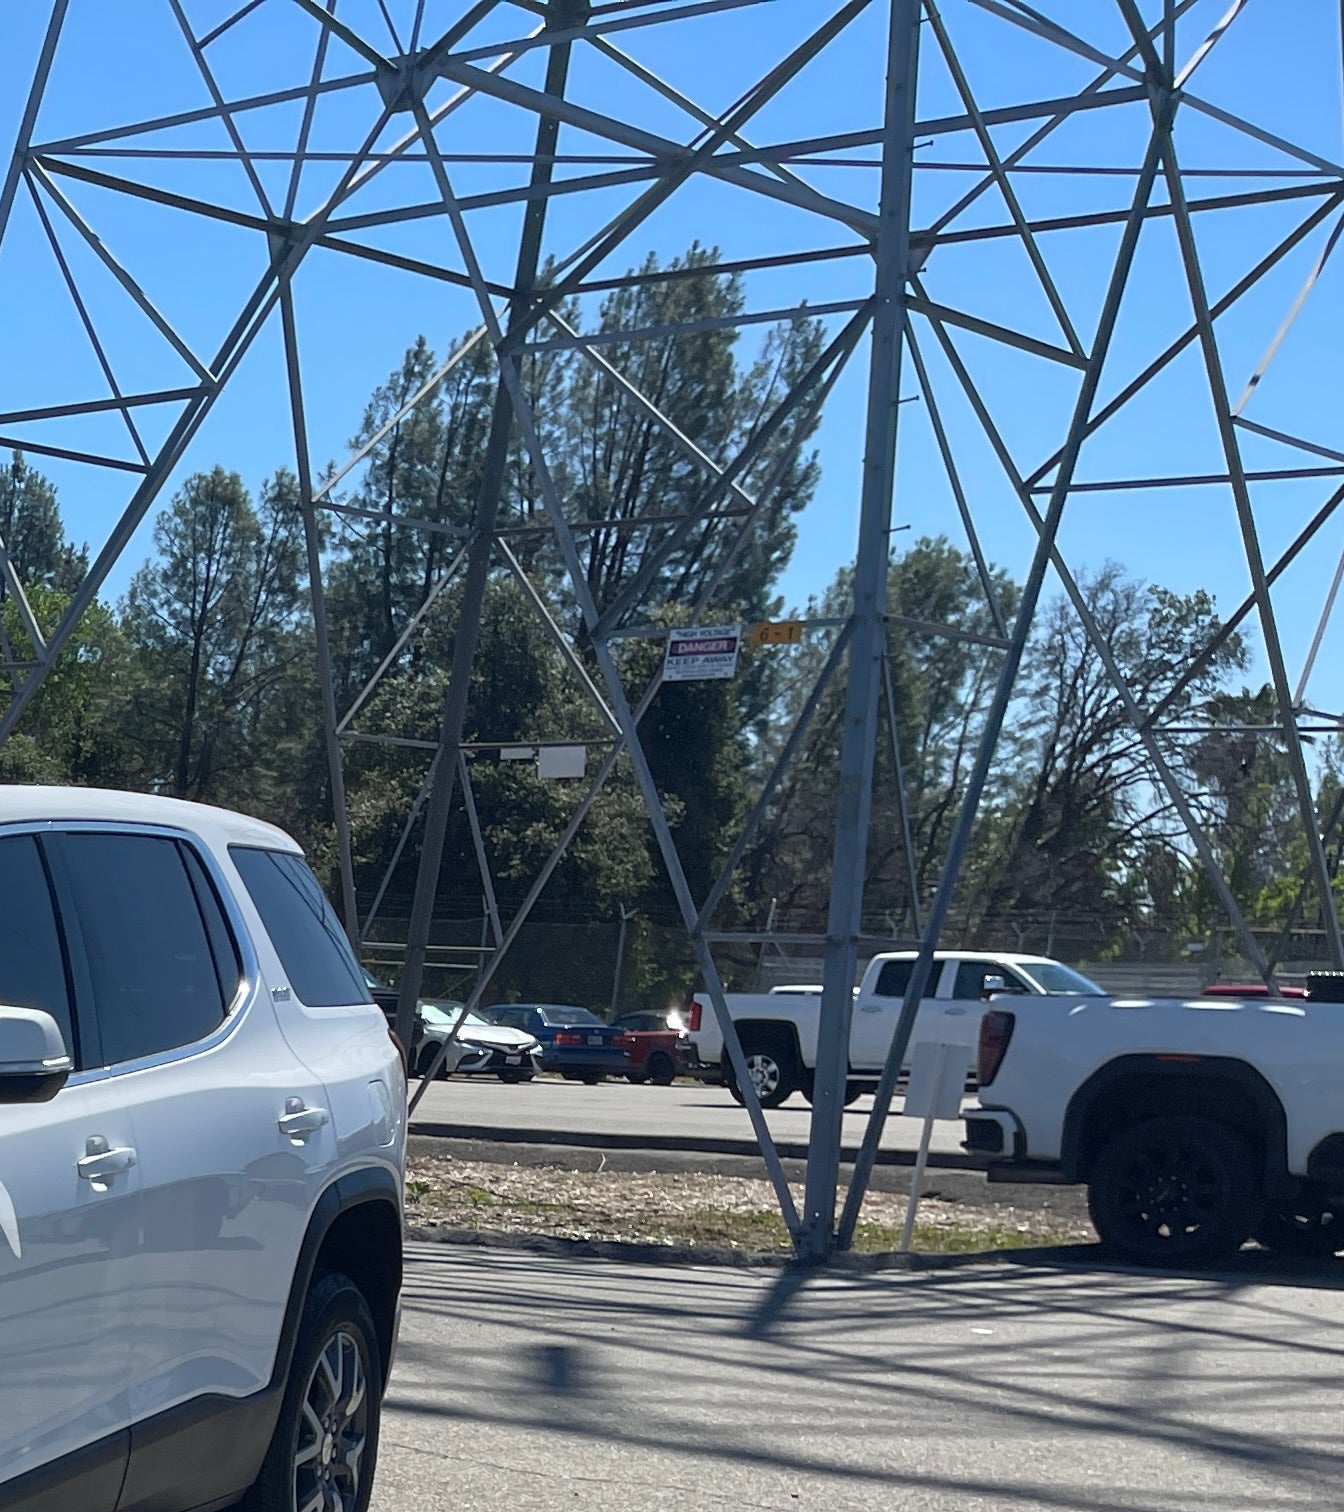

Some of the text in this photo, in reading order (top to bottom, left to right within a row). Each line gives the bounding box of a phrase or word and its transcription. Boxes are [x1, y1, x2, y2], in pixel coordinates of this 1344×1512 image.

[678, 640, 728, 653] DANGER
[667, 654, 735, 666] KEEP AWAY
